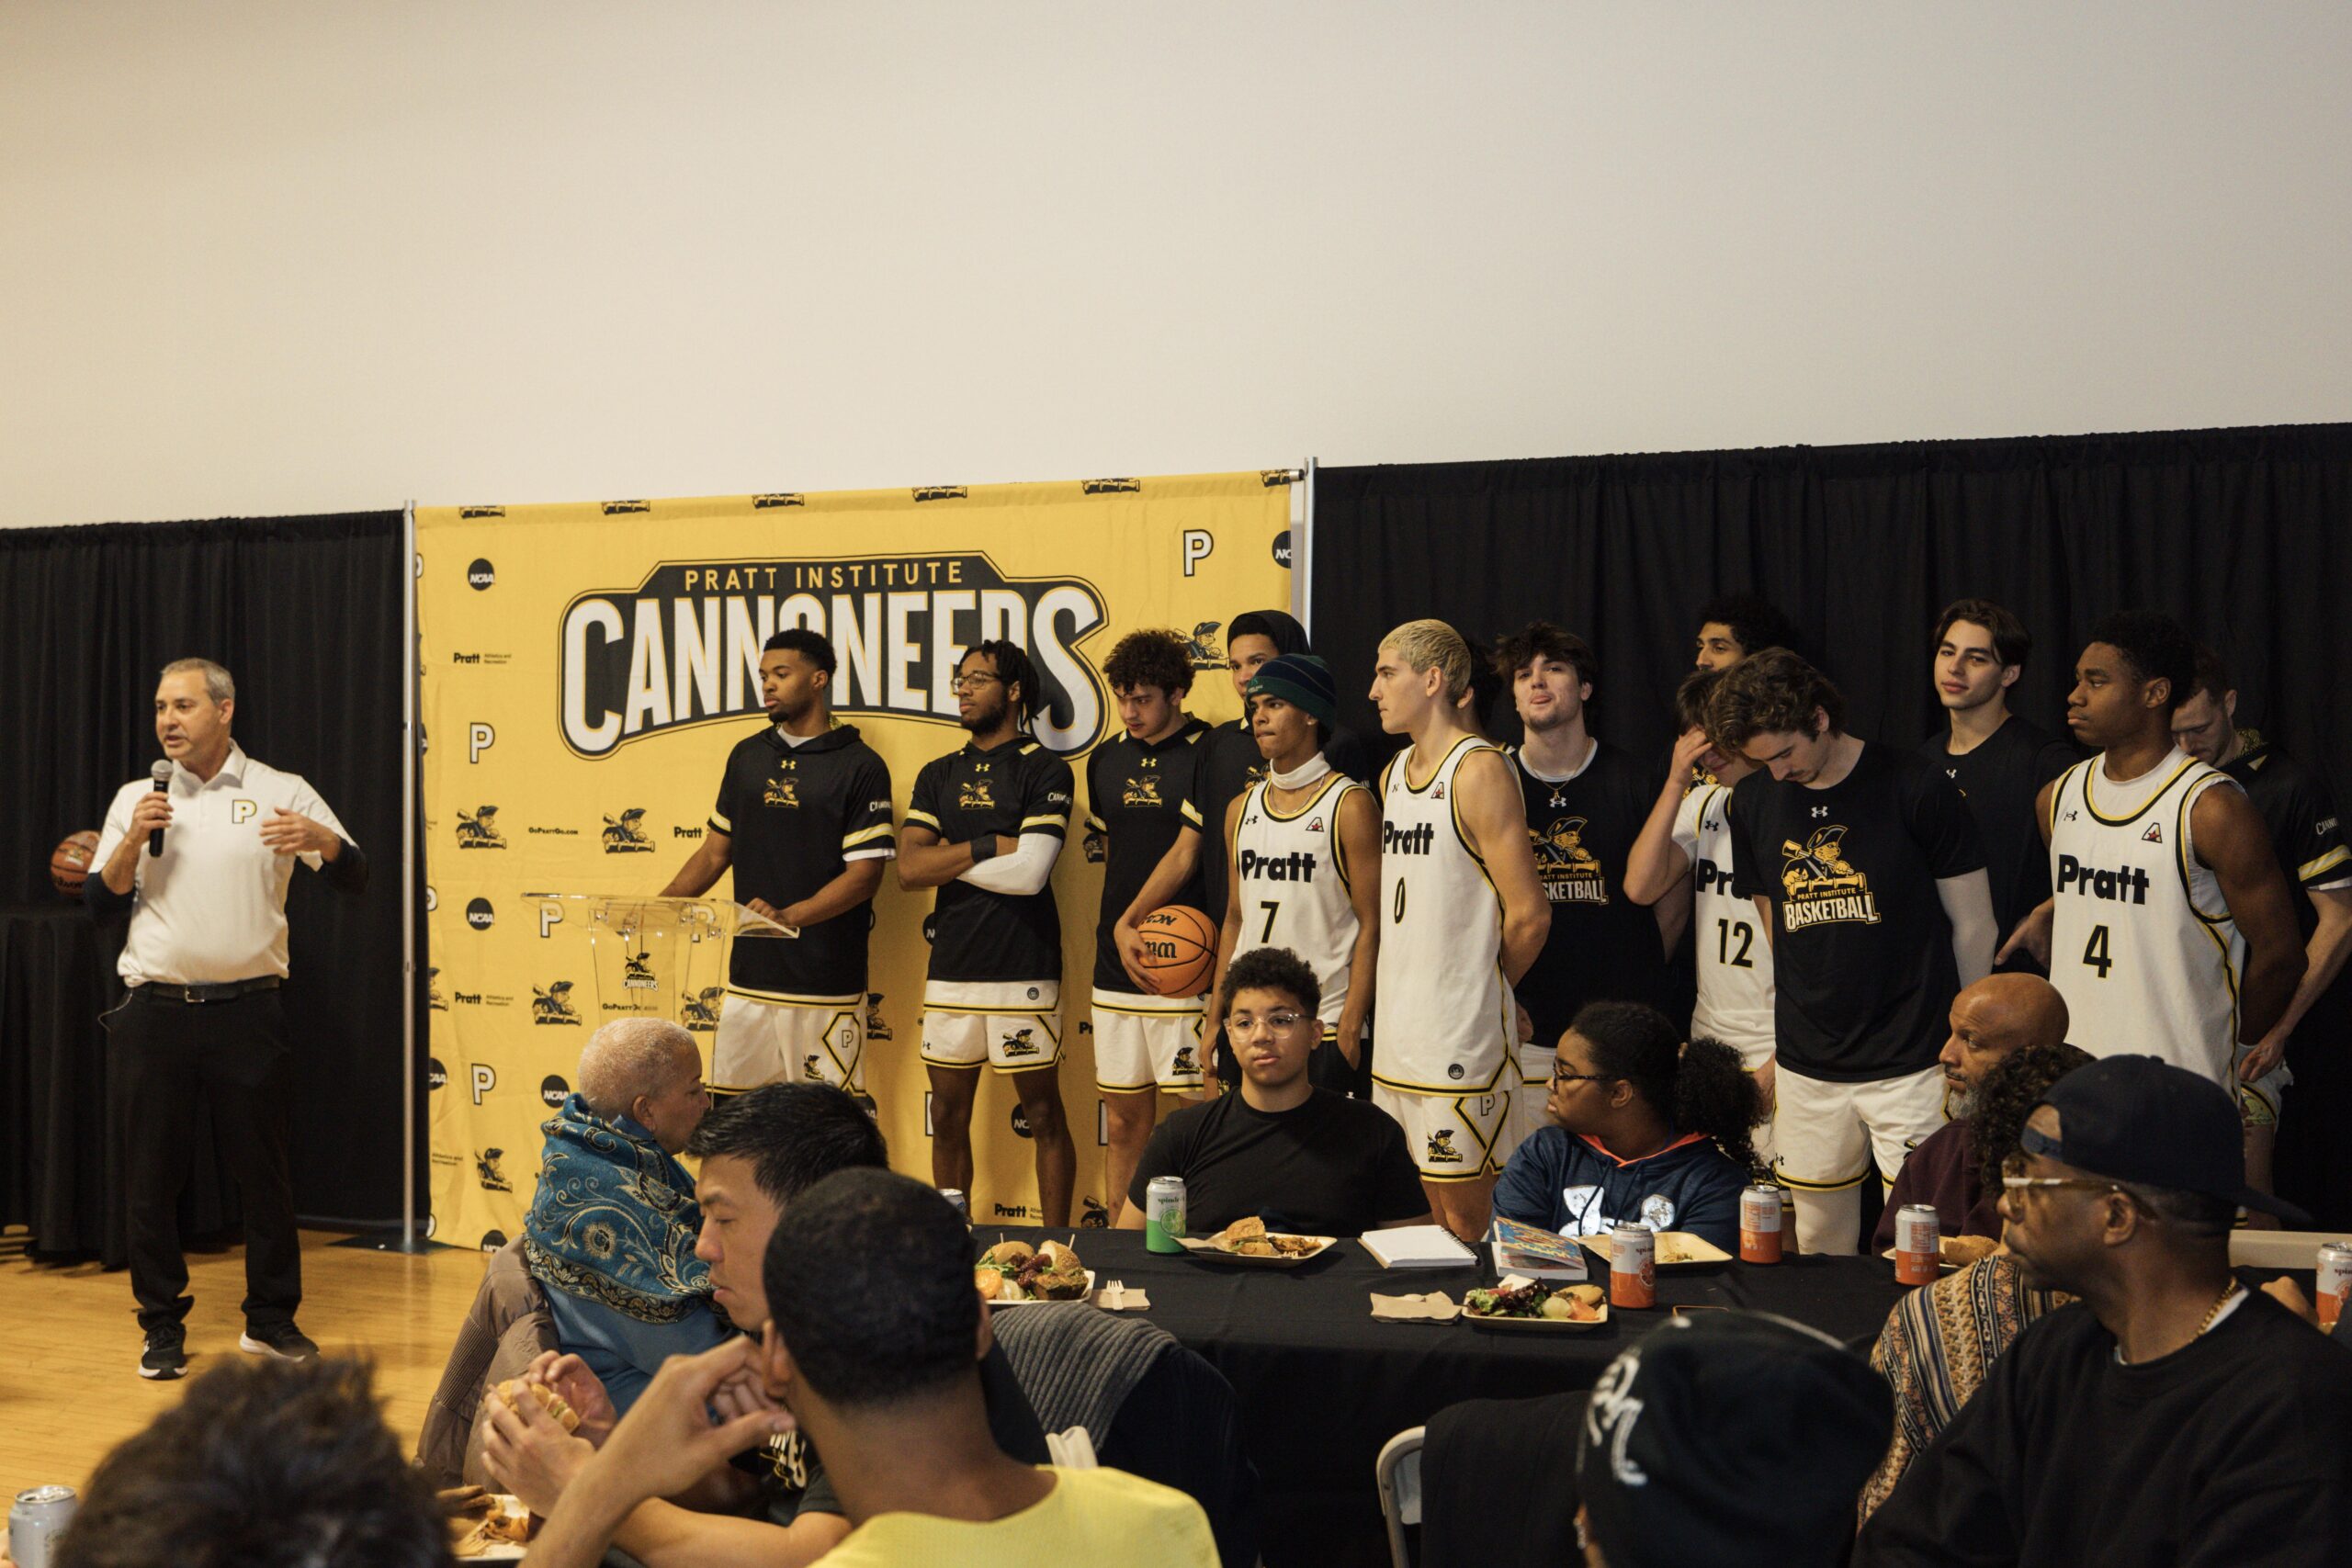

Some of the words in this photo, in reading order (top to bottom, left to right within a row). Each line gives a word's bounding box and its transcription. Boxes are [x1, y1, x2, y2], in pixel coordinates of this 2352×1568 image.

[1182, 528, 1215, 577] P
[469, 572, 495, 584] NCAA
[684, 567, 777, 591] PRATT
[795, 561, 963, 589] INSTITUTE
[453, 651, 481, 664] Pratt
[469, 722, 495, 764] P
[232, 799, 258, 825] P
[673, 826, 702, 839] Pratt
[1383, 819, 1435, 855] Pratt
[1240, 849, 1317, 883] Pratt
[2056, 853, 2150, 906] Pratt
[1394, 876, 1406, 924] 0
[1797, 892, 1818, 900] PRATT
[1820, 887, 1857, 897] INSTITUTE
[469, 912, 494, 923] NCAA
[1260, 900, 1281, 944] 7
[1784, 894, 1879, 931] BASKETBALL
[1717, 918, 1754, 968] 12
[2082, 924, 2113, 979] 4
[454, 991, 482, 1005] Pratt
[470, 1063, 497, 1106] P
[993, 1202, 1027, 1219] Pratt
